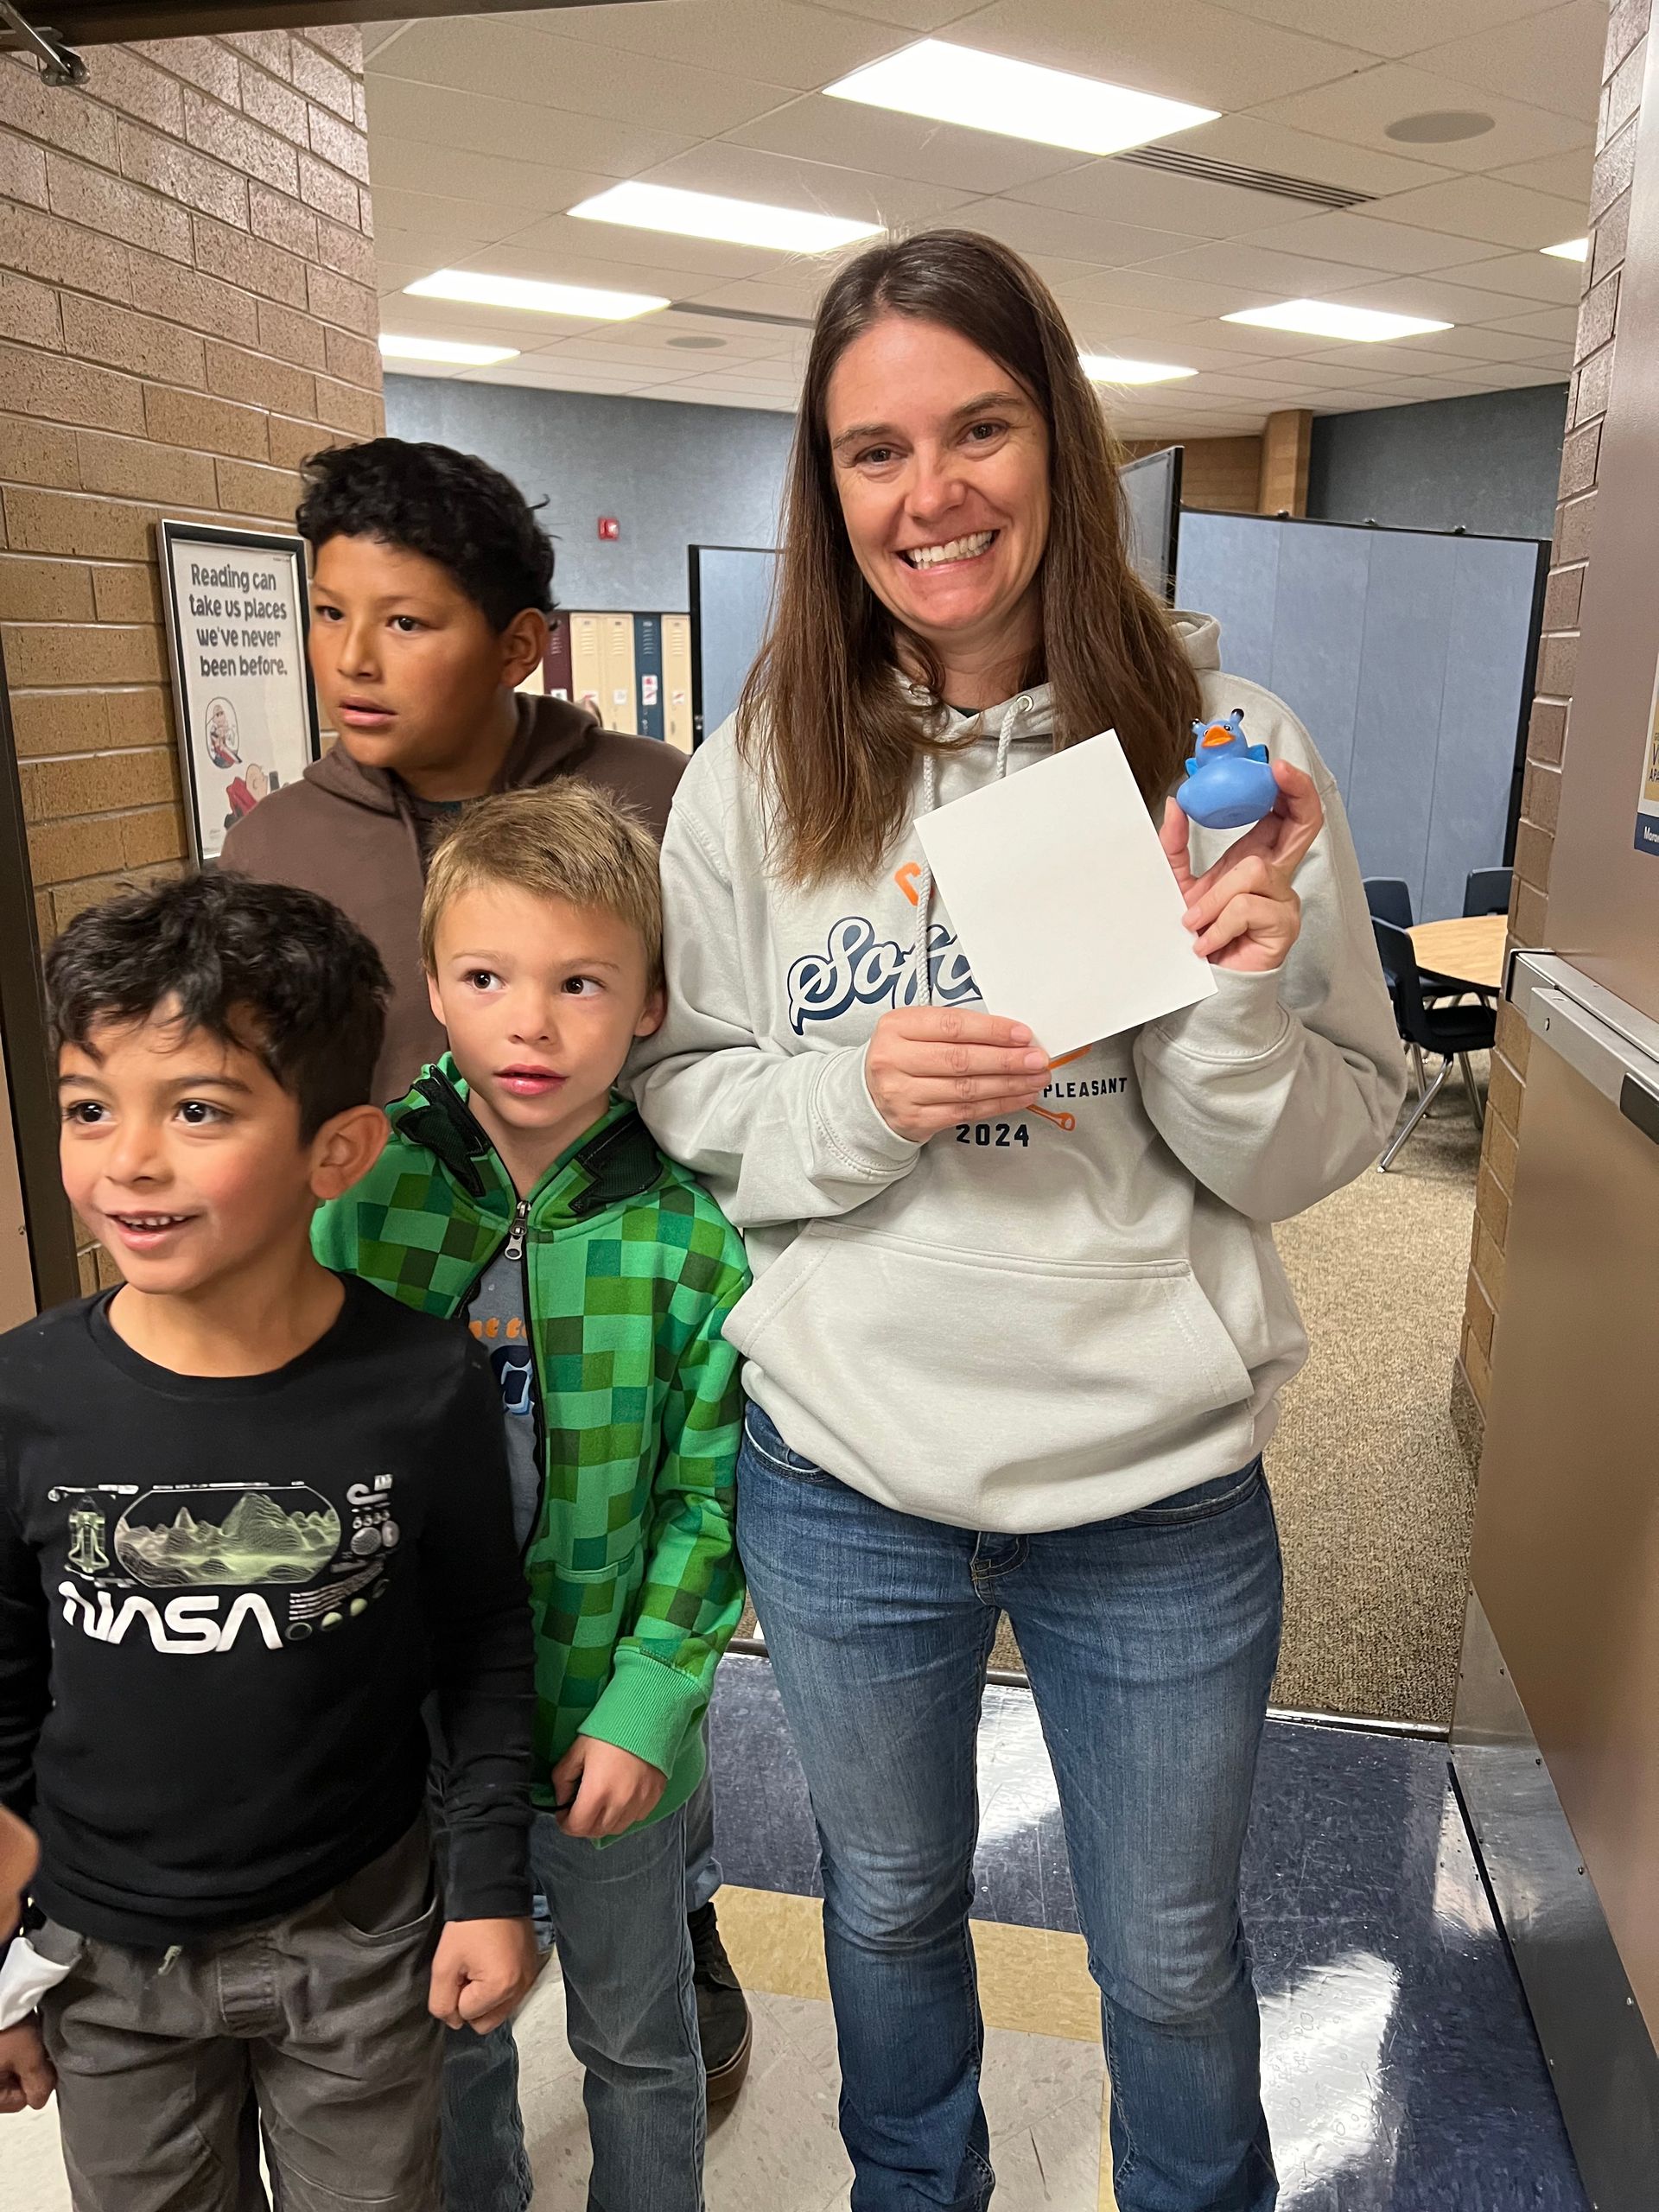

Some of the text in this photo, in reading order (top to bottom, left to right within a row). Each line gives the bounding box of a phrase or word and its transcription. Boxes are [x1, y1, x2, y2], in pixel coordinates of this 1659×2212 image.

[191, 563, 276, 594] Reading can
[189, 594, 288, 621] take us places
[196, 626, 281, 647] we've never
[200, 655, 288, 677] been before.
[1043, 1077, 1128, 1098] PLEASANT
[956, 1123, 1029, 1147] 2024
[59, 1581, 283, 1654] NASA
